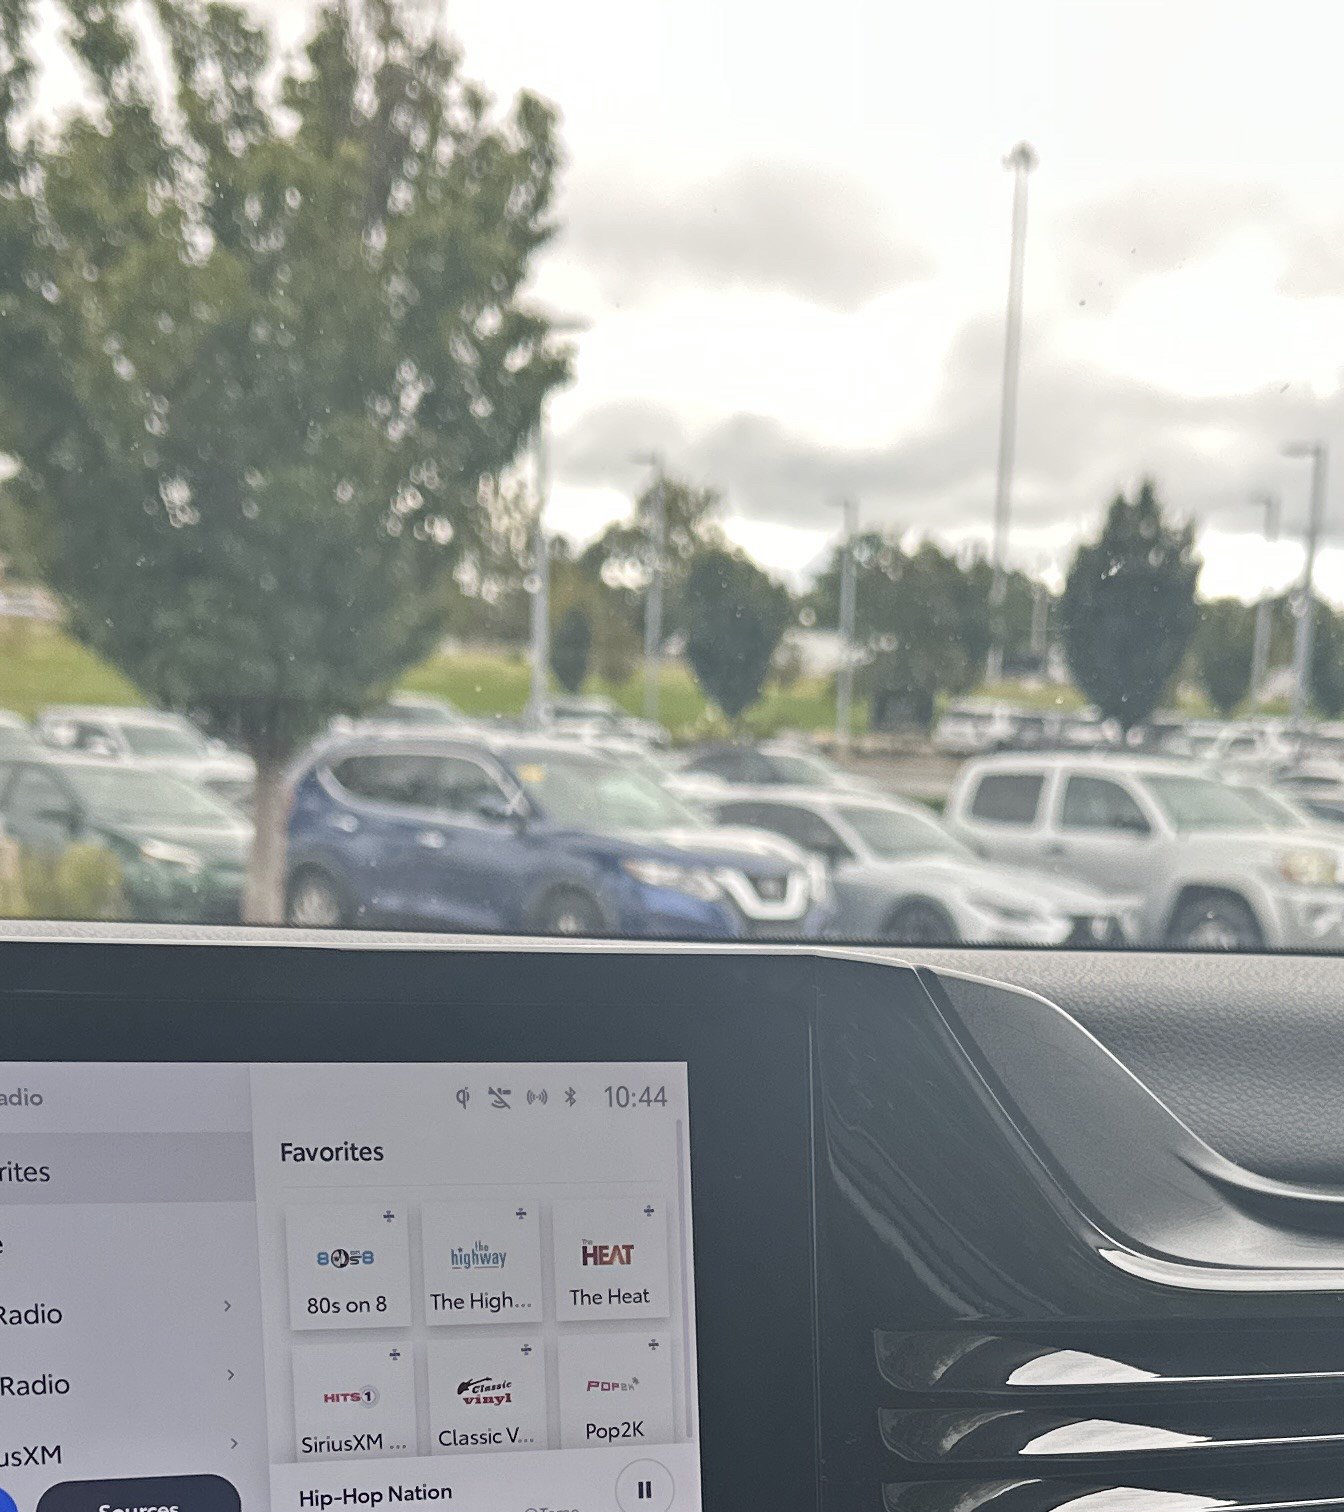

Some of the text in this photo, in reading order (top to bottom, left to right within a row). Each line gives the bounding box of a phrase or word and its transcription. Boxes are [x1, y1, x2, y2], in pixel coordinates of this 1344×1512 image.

[602, 1085, 668, 1109] 10:44
[280, 1141, 385, 1163] Favorites
[450, 1246, 508, 1270] highway
[582, 1244, 635, 1266] HEAT
[307, 1295, 388, 1314] 80s on 8
[429, 1290, 532, 1313] The High...
[568, 1288, 651, 1306] The Heat
[323, 1390, 372, 1403] HITS 1
[471, 1379, 513, 1395] Classic
[462, 1392, 512, 1407] vinyl
[438, 1427, 503, 1447] Classic
[586, 1420, 645, 1443] Pop2K
[301, 1433, 383, 1454] SiriusXM
[299, 1483, 454, 1511] Hip-Hop Nation
